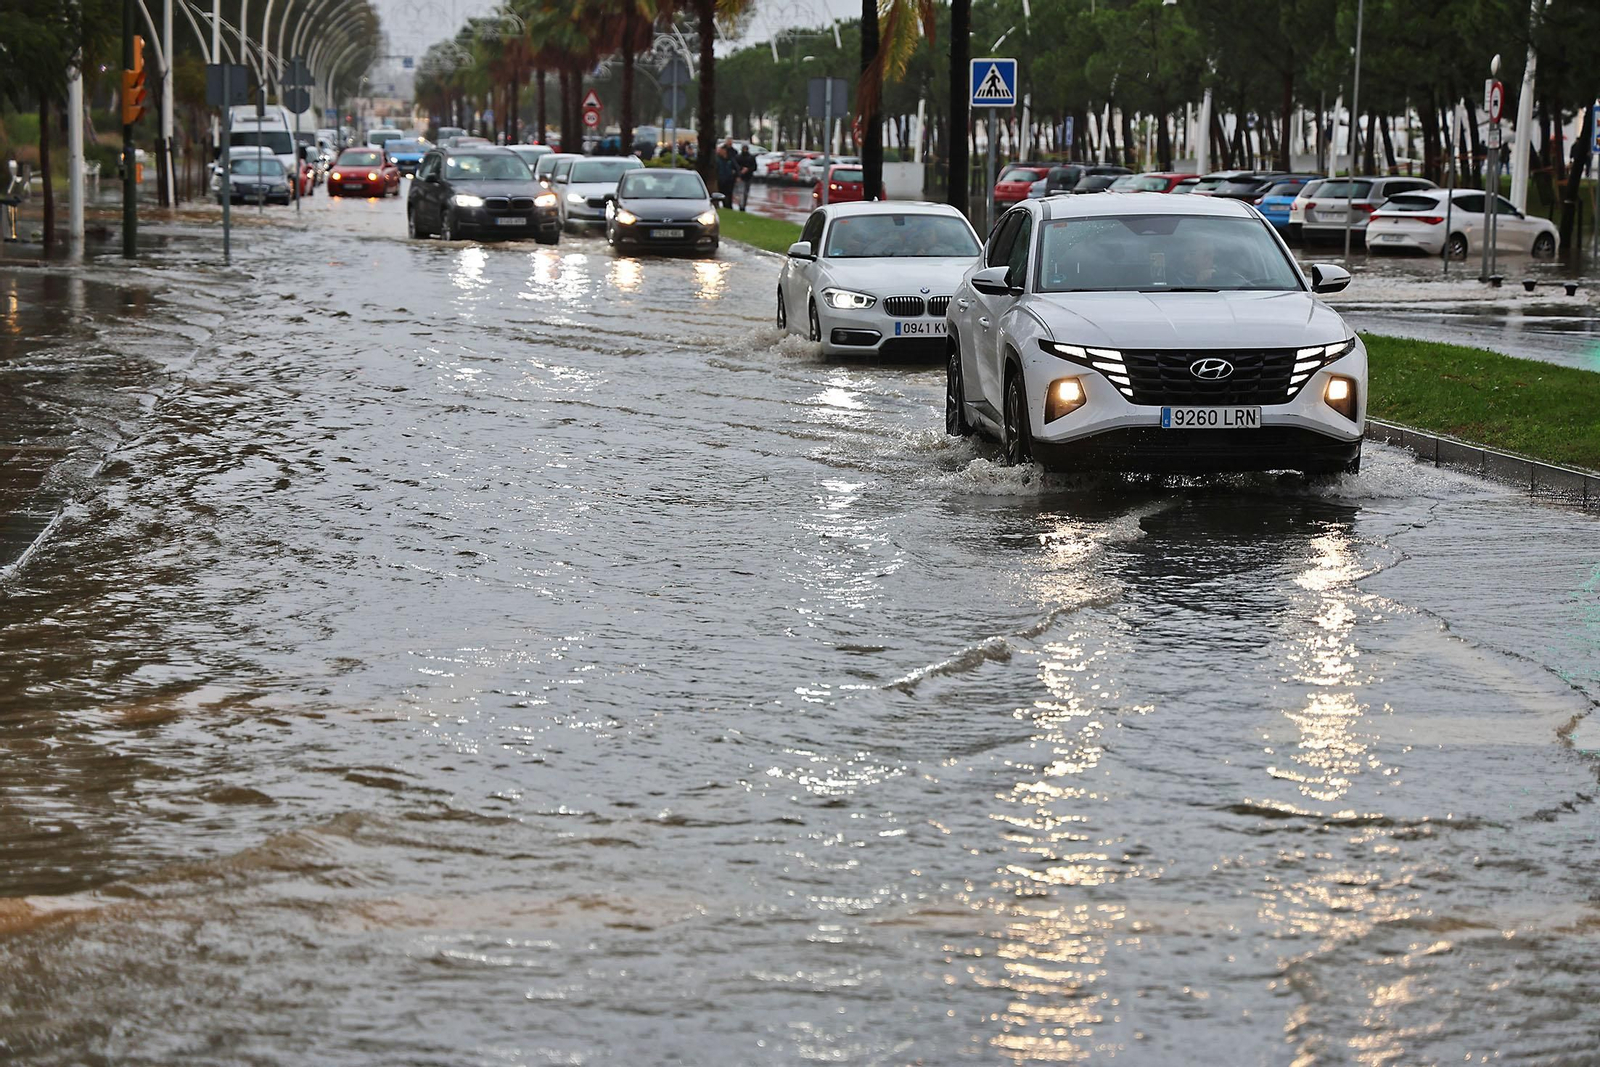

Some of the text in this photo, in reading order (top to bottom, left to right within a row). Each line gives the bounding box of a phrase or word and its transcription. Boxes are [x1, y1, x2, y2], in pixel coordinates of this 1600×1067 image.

[903, 323, 930, 334] 0941
[1175, 409, 1256, 426] 9260 LRN
